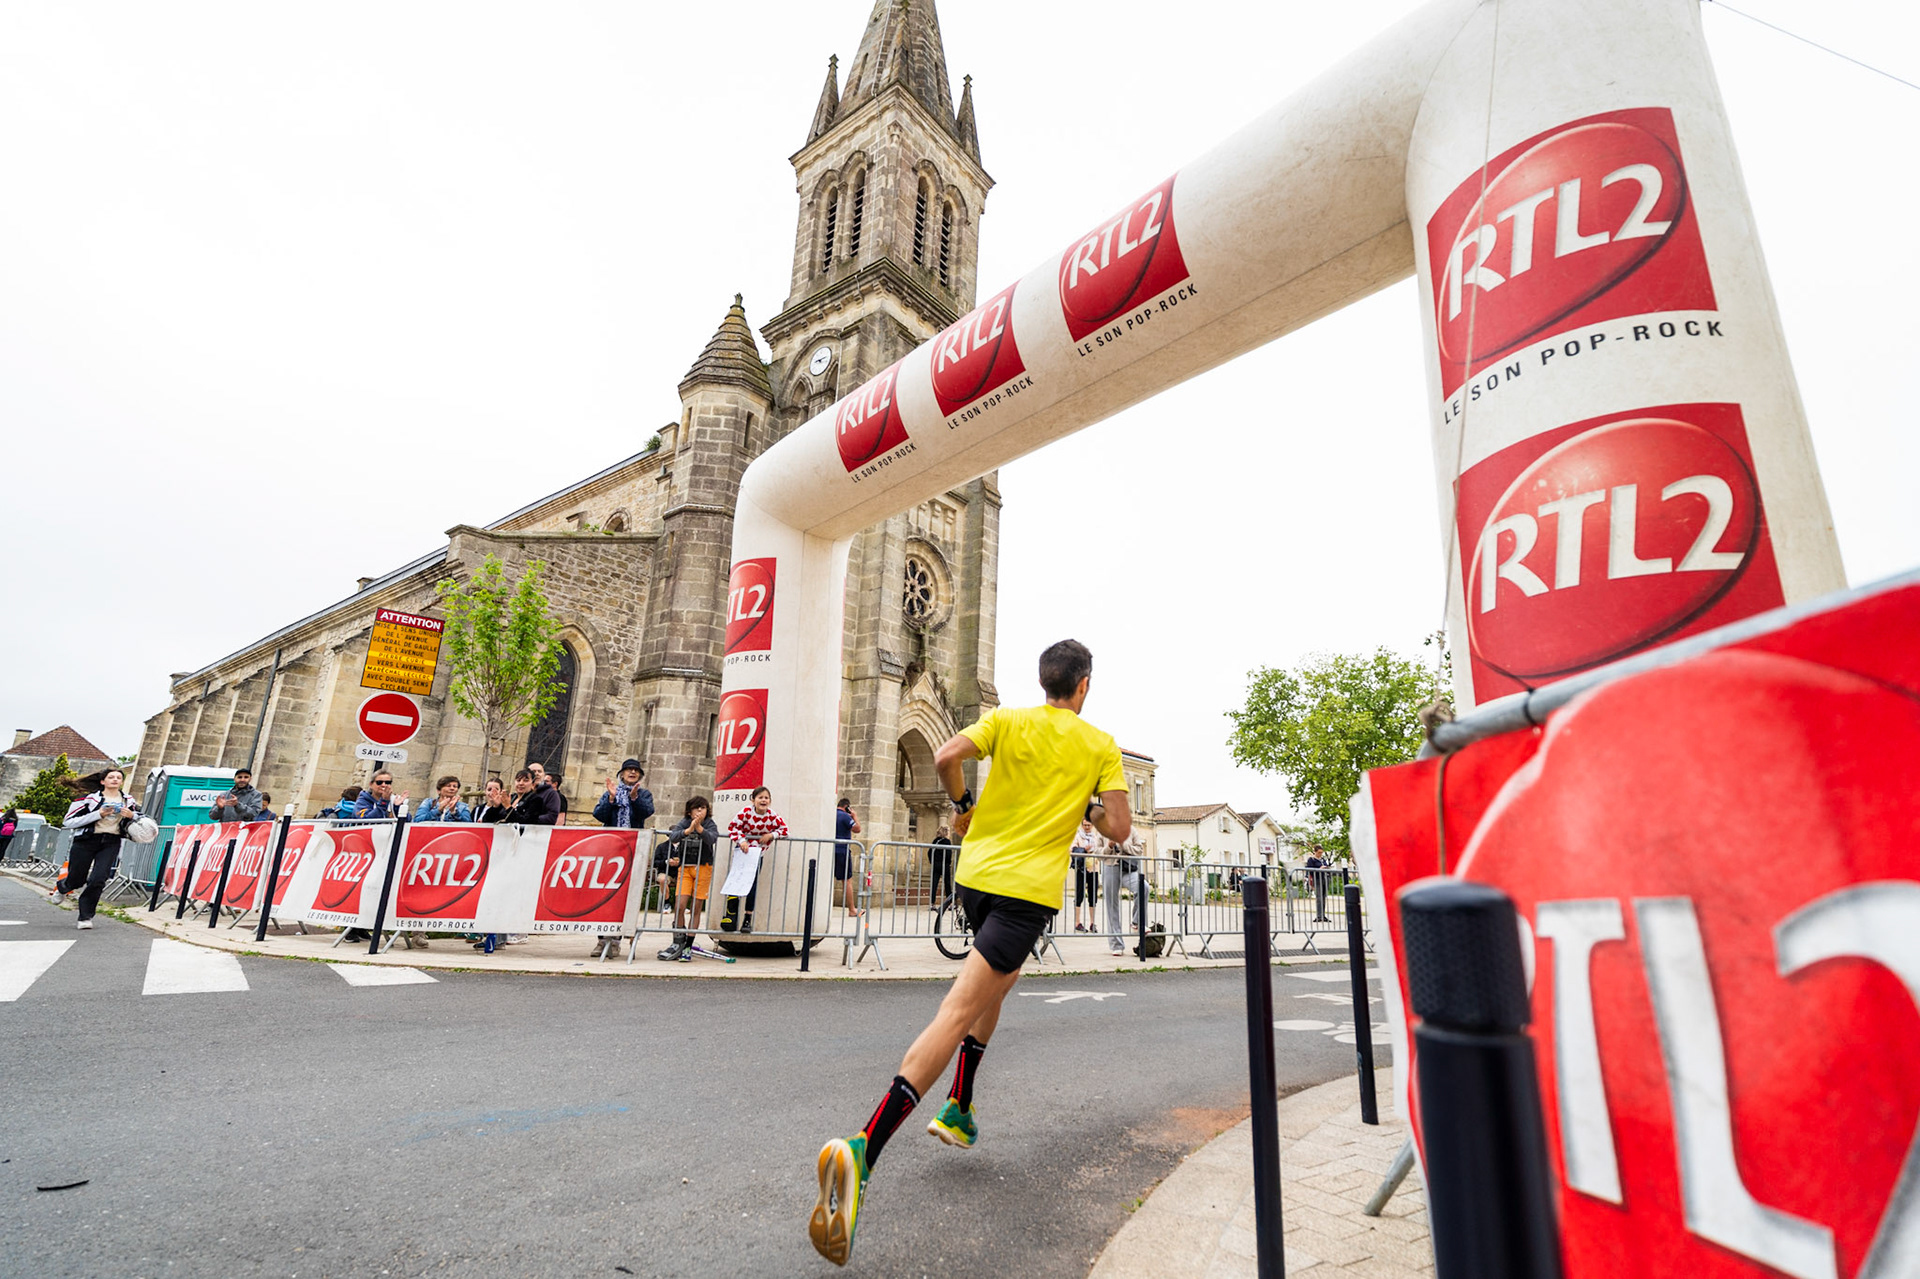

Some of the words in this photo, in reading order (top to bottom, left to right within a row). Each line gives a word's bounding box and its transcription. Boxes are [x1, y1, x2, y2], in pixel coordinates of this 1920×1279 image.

[1069, 191, 1163, 290] RTL2
[1449, 163, 1672, 322] RTL2
[938, 296, 1007, 374] RTL2
[1077, 343, 1093, 357] LE
[1096, 325, 1123, 347] SON
[1126, 283, 1198, 330] POP-ROCK
[1443, 400, 1460, 425] LE
[1470, 362, 1522, 401] SON
[1540, 320, 1724, 366] POP-ROCK
[841, 372, 894, 436] RTL2
[947, 418, 959, 430] LE
[961, 406, 981, 422] SON
[983, 376, 1034, 410] POP-ROCK
[851, 473, 861, 483] LE
[861, 464, 878, 478] SON
[878, 442, 917, 469] POP-ROCK
[1481, 474, 1746, 614] RTL2
[380, 611, 441, 630] ATTENTION
[726, 584, 766, 626] TL2
[375, 621, 390, 629] MISE
[400, 625, 417, 634] SENS
[419, 628, 440, 639] UNIQUE
[404, 634, 428, 643] AVENUE
[414, 643, 438, 652] GAULLE
[385, 676, 410, 685] DOUBLE
[361, 748, 384, 757] SAUF
[717, 717, 758, 757] TL2
[234, 846, 264, 878] RTL2
[326, 851, 372, 882] RTL2
[408, 853, 482, 886] RTL2
[550, 856, 626, 889] RTL2
[427, 921, 475, 929] POP-ROCK
[574, 924, 622, 932] POP-ROCK
